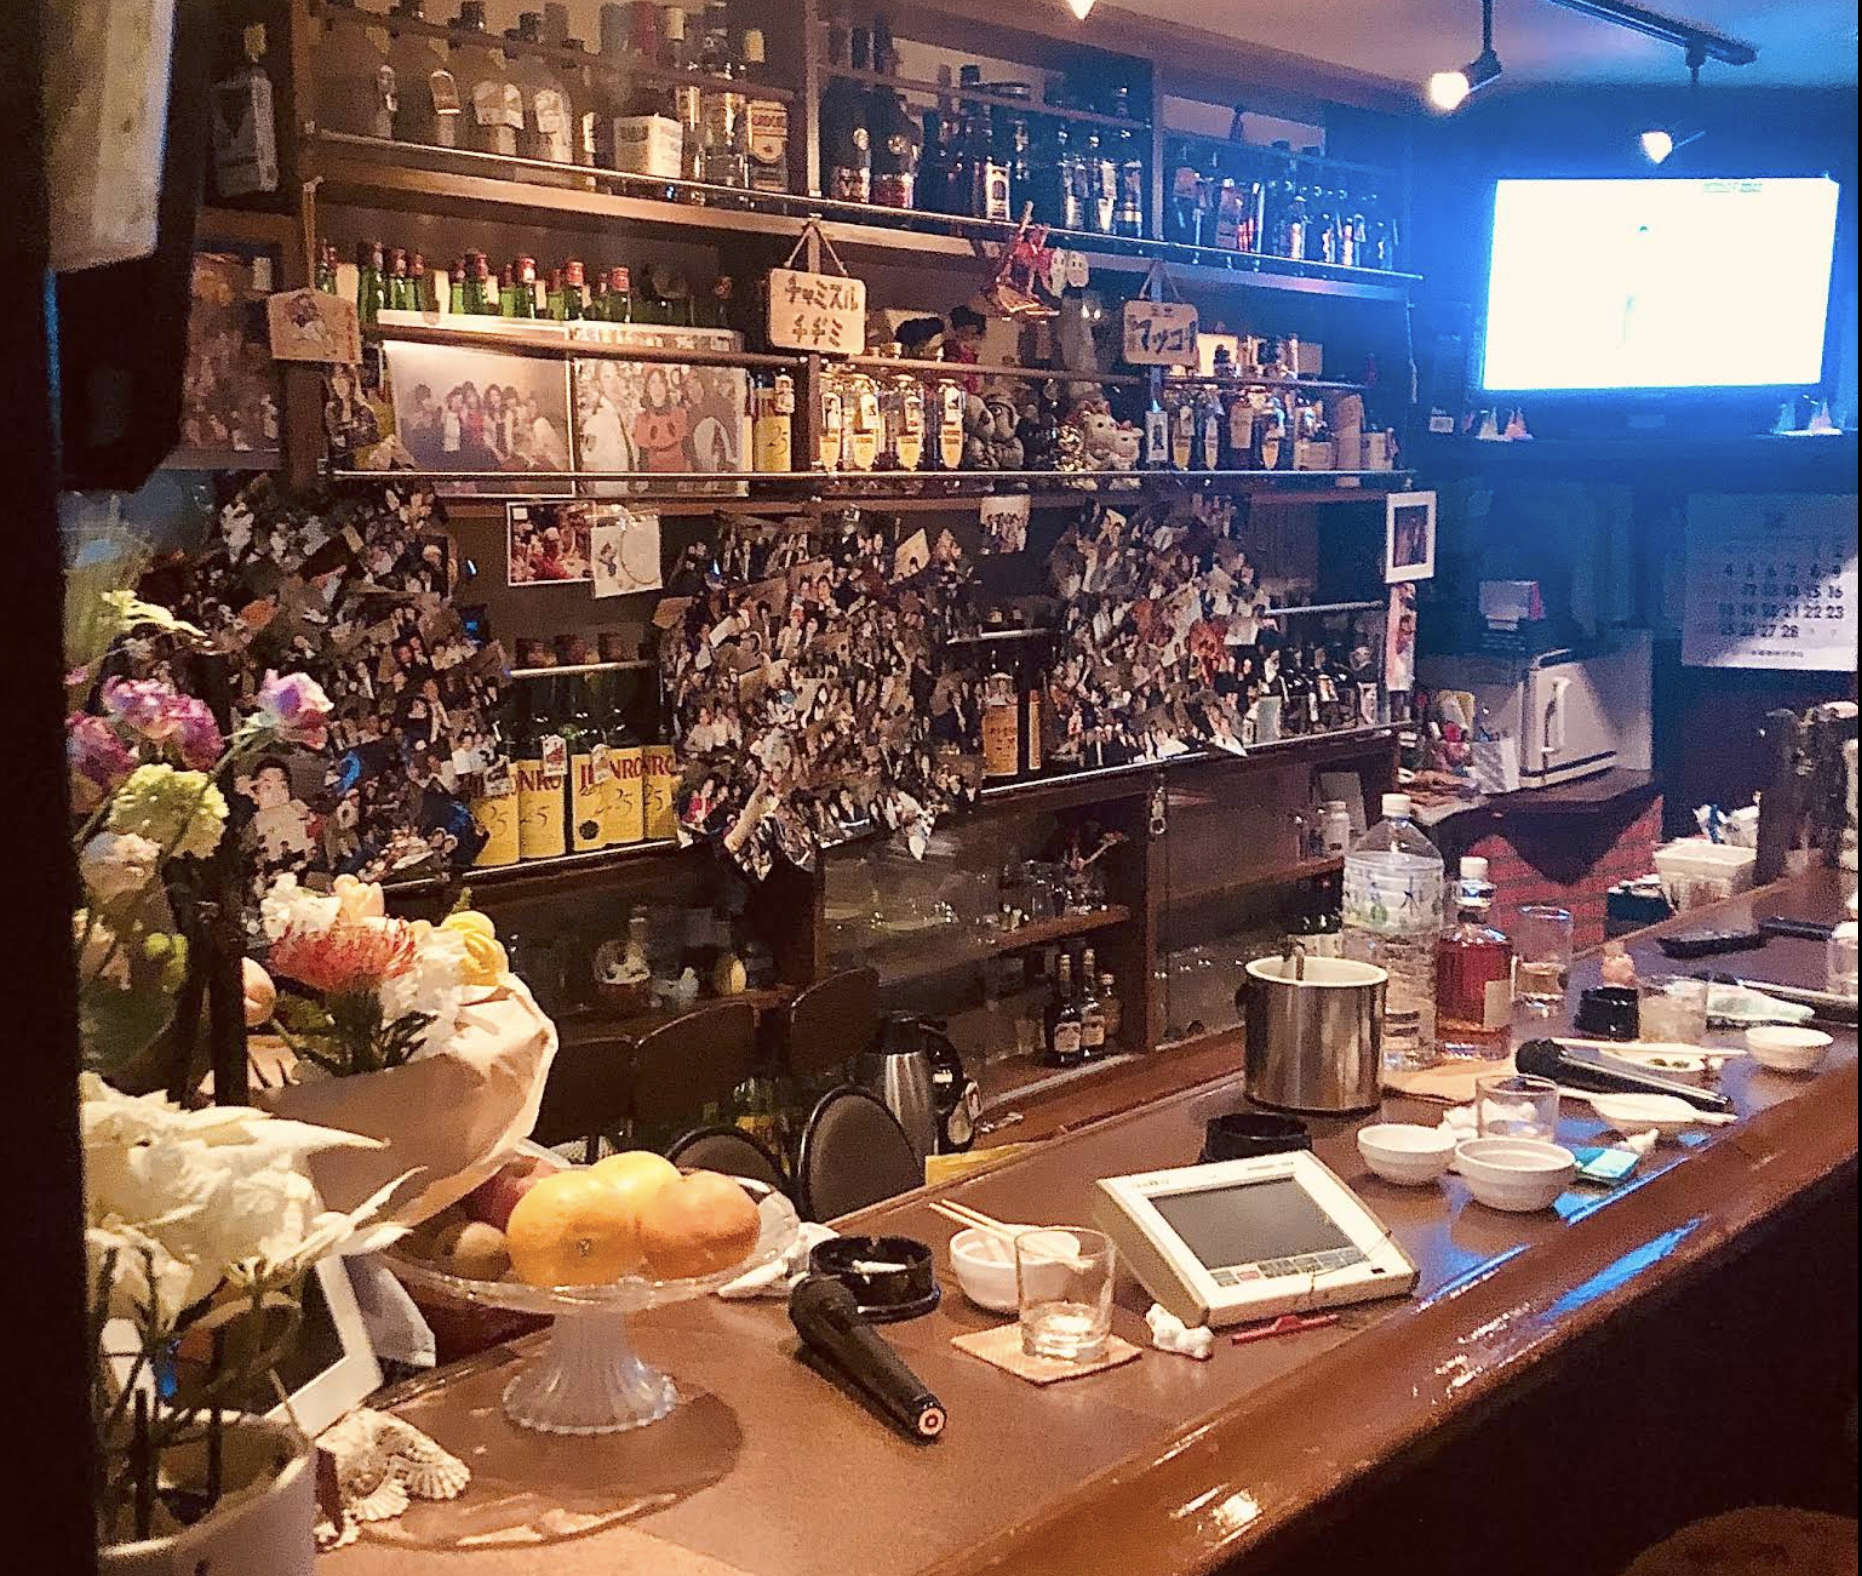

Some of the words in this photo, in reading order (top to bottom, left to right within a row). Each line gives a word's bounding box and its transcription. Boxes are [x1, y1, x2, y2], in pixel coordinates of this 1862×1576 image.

[1828, 585, 1844, 599] 16
[1804, 605, 1822, 619] 22
[1826, 605, 1844, 620] 23
[1781, 624, 1799, 638] 28
